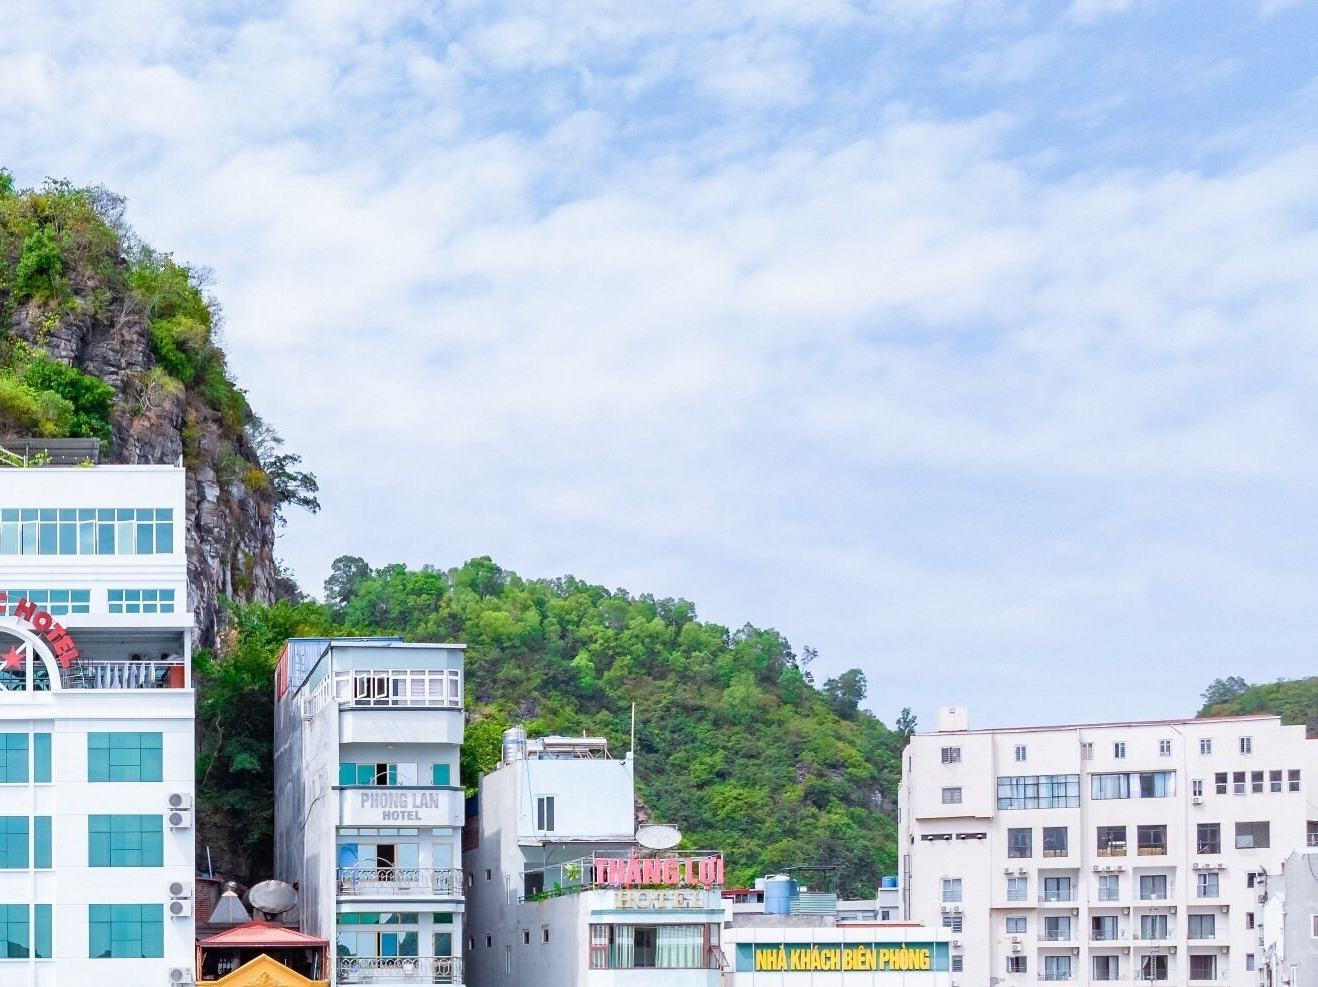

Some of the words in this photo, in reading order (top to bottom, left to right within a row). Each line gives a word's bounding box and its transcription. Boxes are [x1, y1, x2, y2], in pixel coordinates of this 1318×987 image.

[13, 597, 79, 669] HOTEL
[361, 792, 408, 808] PHONG
[412, 792, 439, 808] LAN
[382, 810, 422, 820] HOTEL
[615, 891, 704, 908] HOTEL
[755, 945, 788, 971] NHÀ
[790, 946, 841, 971] KHÁCH
[843, 945, 877, 971] BIÊN
[879, 943, 930, 971] PHÒNG
